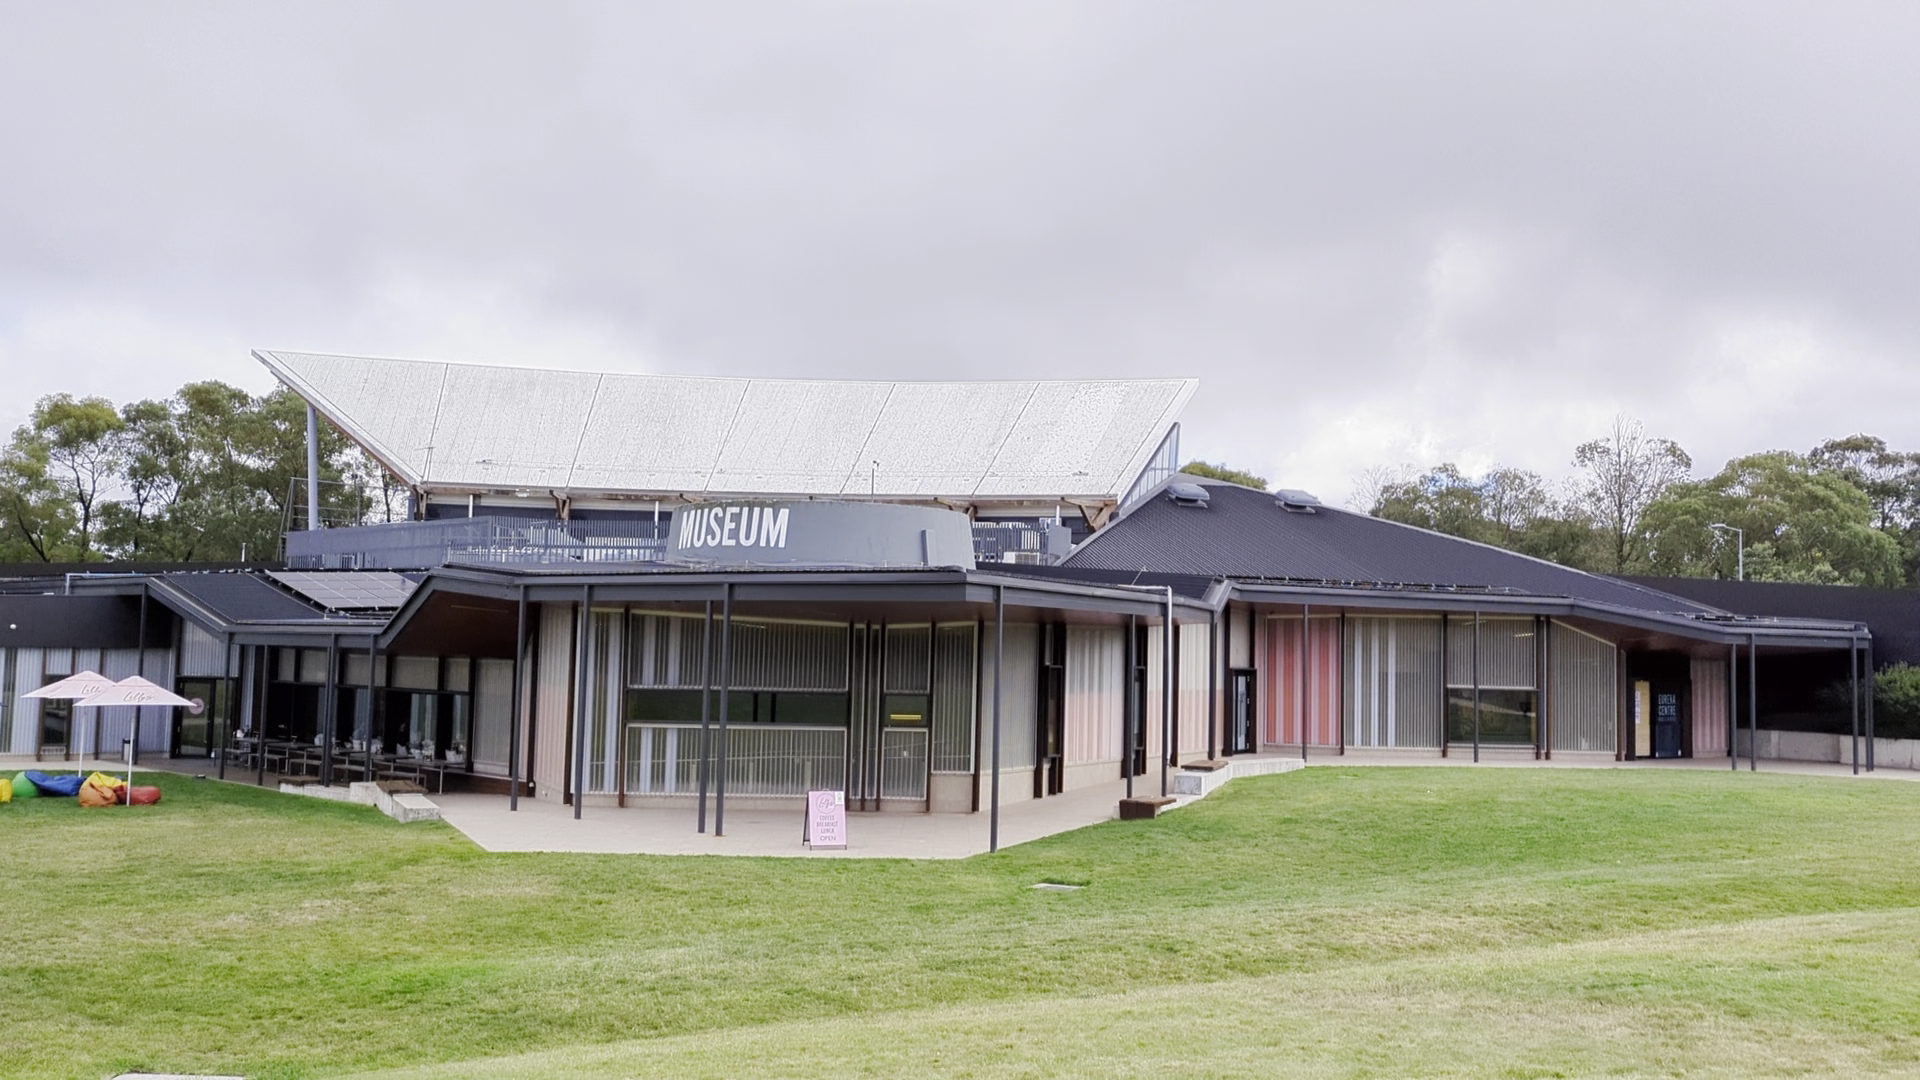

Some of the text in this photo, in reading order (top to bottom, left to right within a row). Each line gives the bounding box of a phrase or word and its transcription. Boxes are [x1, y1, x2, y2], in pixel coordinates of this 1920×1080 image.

[678, 506, 790, 550] MUSEUM
[1658, 694, 1676, 705] EUREKA
[1658, 705, 1676, 716] CENTRE
